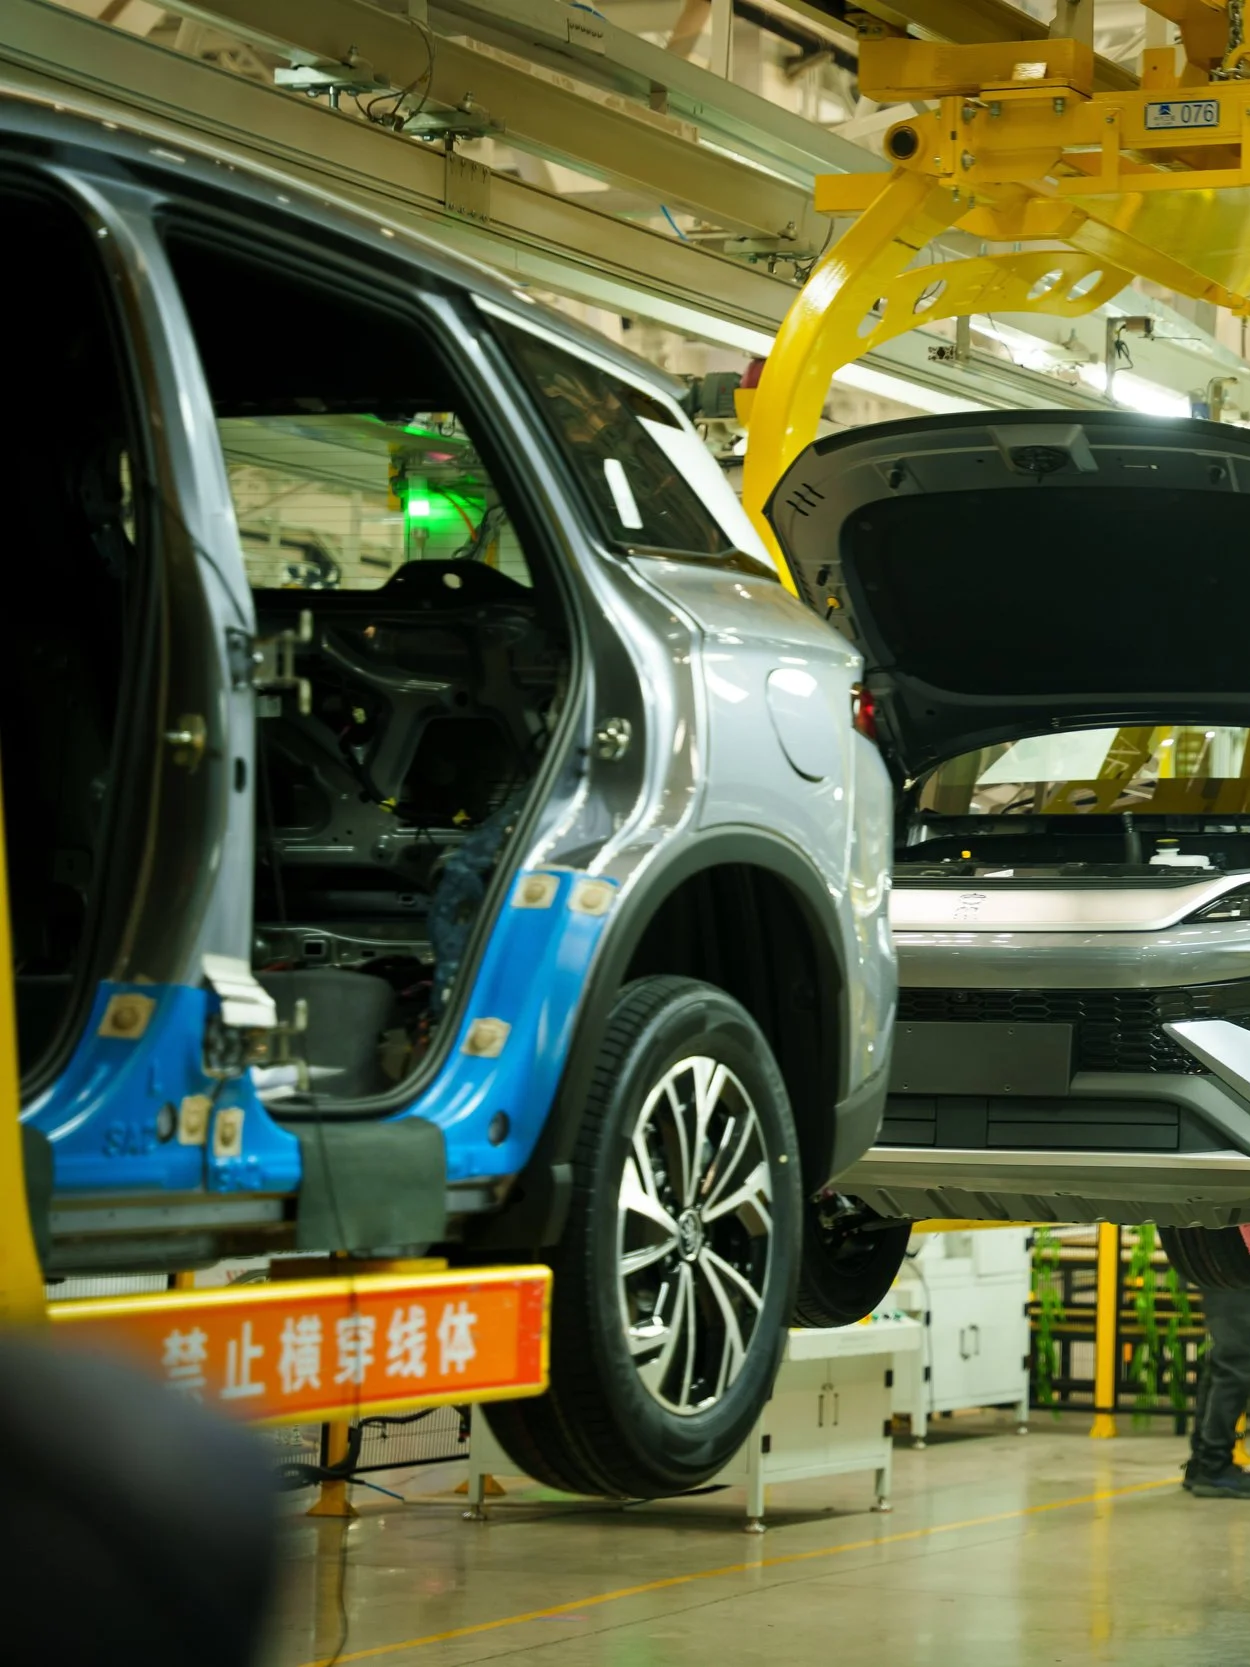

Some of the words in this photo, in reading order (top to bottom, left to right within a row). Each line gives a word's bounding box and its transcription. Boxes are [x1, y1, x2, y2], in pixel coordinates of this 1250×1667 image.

[1181, 103, 1214, 123] 076
[161, 1301, 477, 1402] 禁止横穿线体
